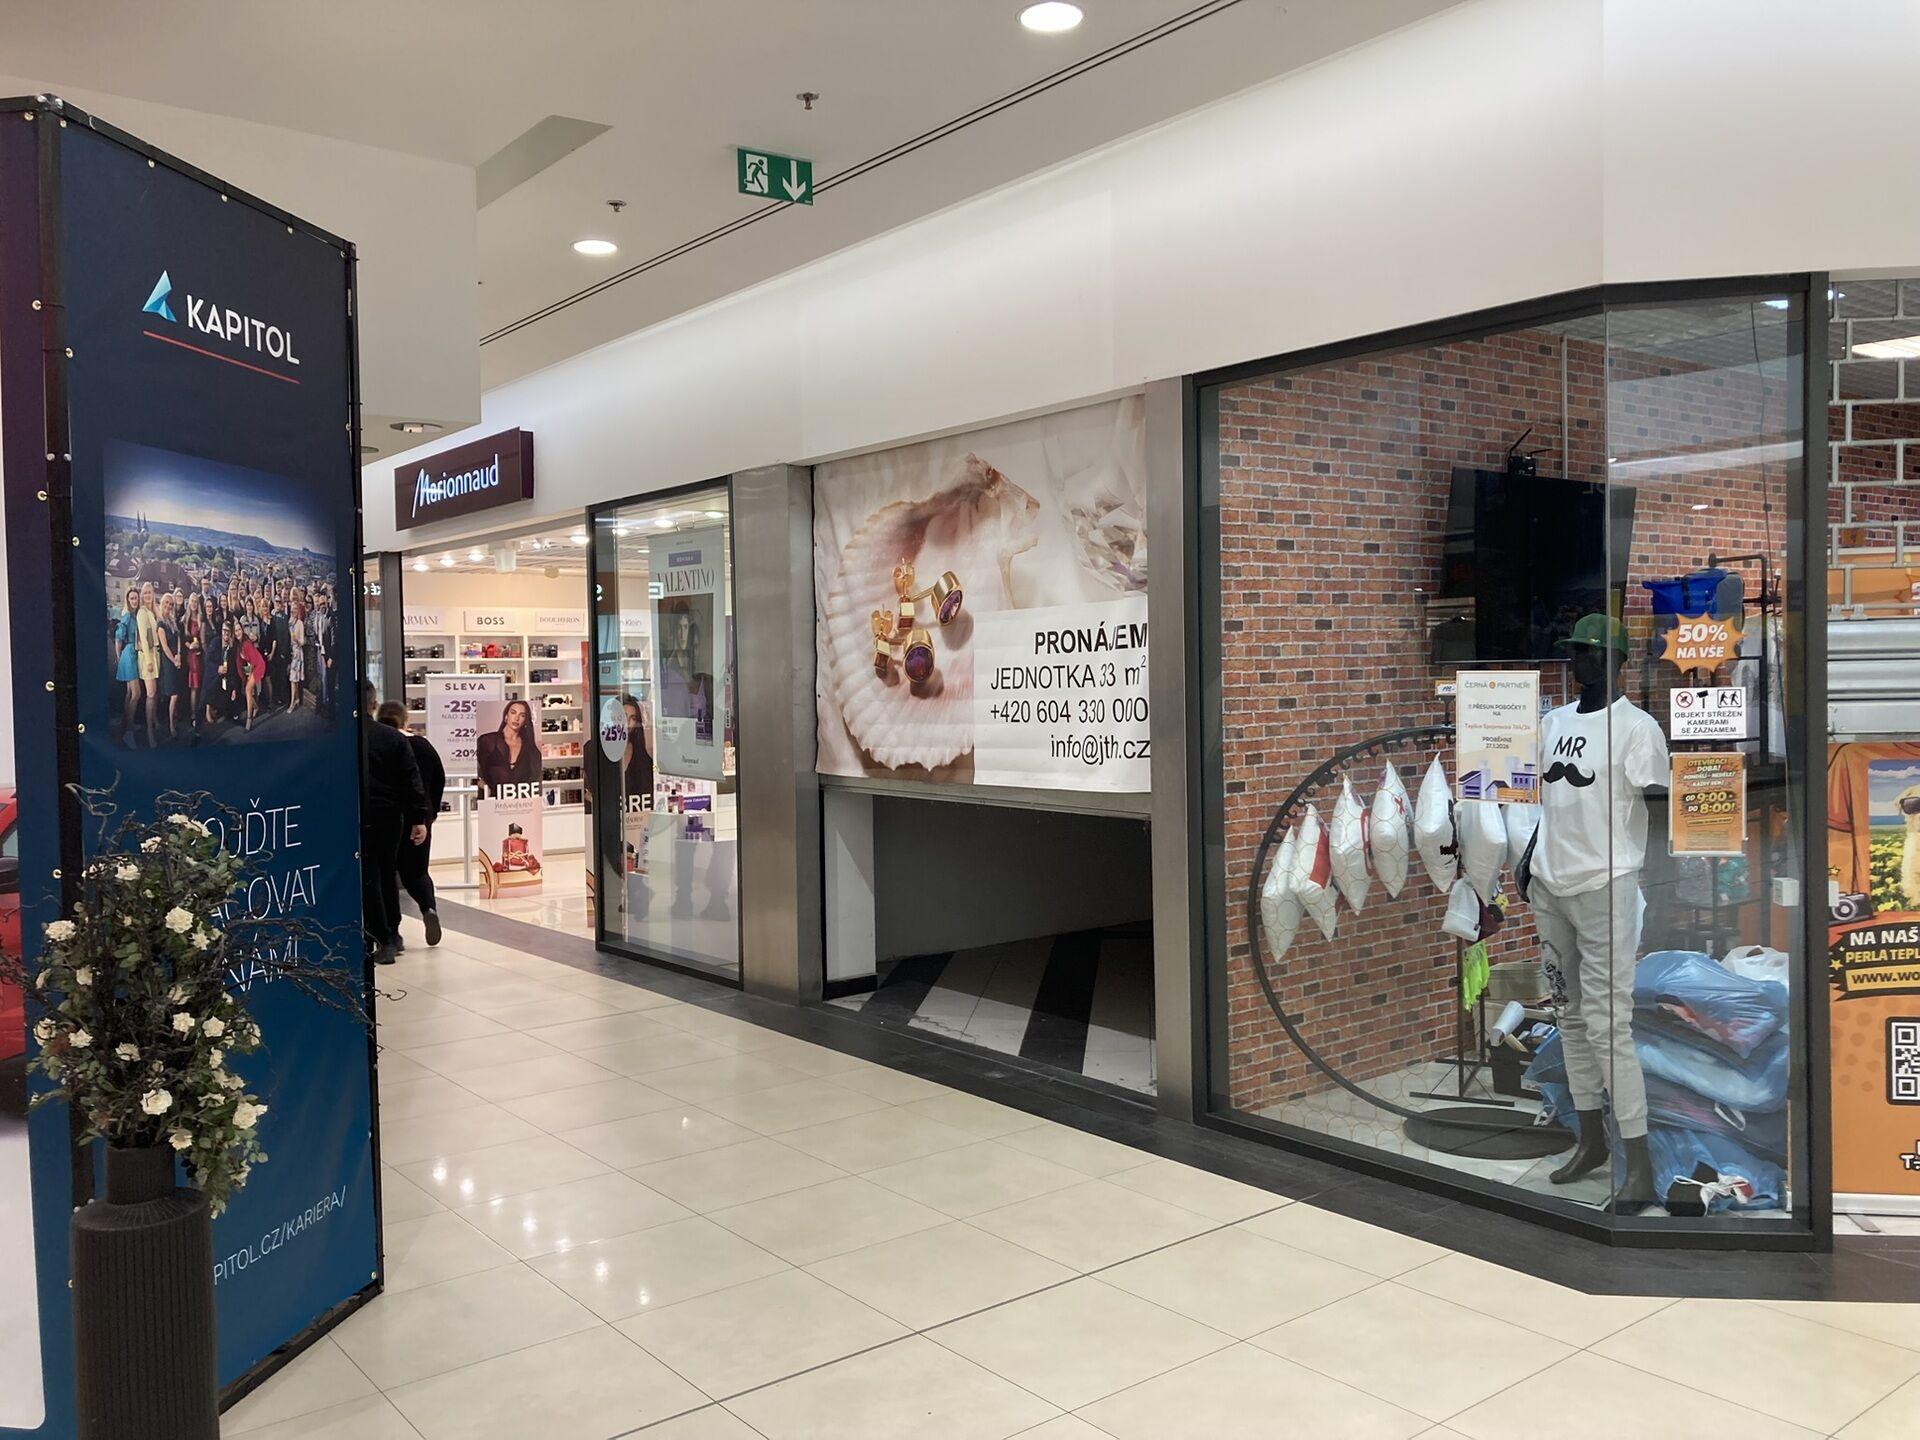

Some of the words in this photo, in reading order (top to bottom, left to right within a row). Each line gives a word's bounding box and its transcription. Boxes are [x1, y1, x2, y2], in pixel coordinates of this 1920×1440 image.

[186, 294, 300, 366] KAPITOL
[411, 453, 499, 518] Marionnaud
[657, 569, 715, 593] VALENTINO
[477, 616, 505, 625] BOSS
[1034, 621, 1148, 654] PRONÁJEM
[1677, 623, 1728, 643] 50%
[1676, 647, 1697, 658] NA
[1700, 644, 1725, 658] VŠE
[990, 664, 1096, 690] JEDNOTKA
[1099, 662, 1116, 687] 33
[1465, 680, 1487, 689] ČERNÁ
[445, 682, 486, 691] SLEVA
[990, 700, 1031, 723] +420
[1036, 700, 1071, 723] 604
[1078, 699, 1105, 723] 330
[1112, 696, 1149, 723] 000
[601, 726, 627, 742] -25%
[1050, 734, 1150, 766] info@jth.cz
[1553, 736, 1587, 759] MR
[483, 781, 540, 800] LIBRE
[1697, 791, 1727, 803] 9:00
[1699, 803, 1735, 813] 8:00!
[192, 797, 302, 860] OJĎTE
[1850, 932, 1876, 946] NA
[1845, 950, 1887, 964] PERLA
[213, 1185, 346, 1286] PITOL.CZ/KARIERA/
